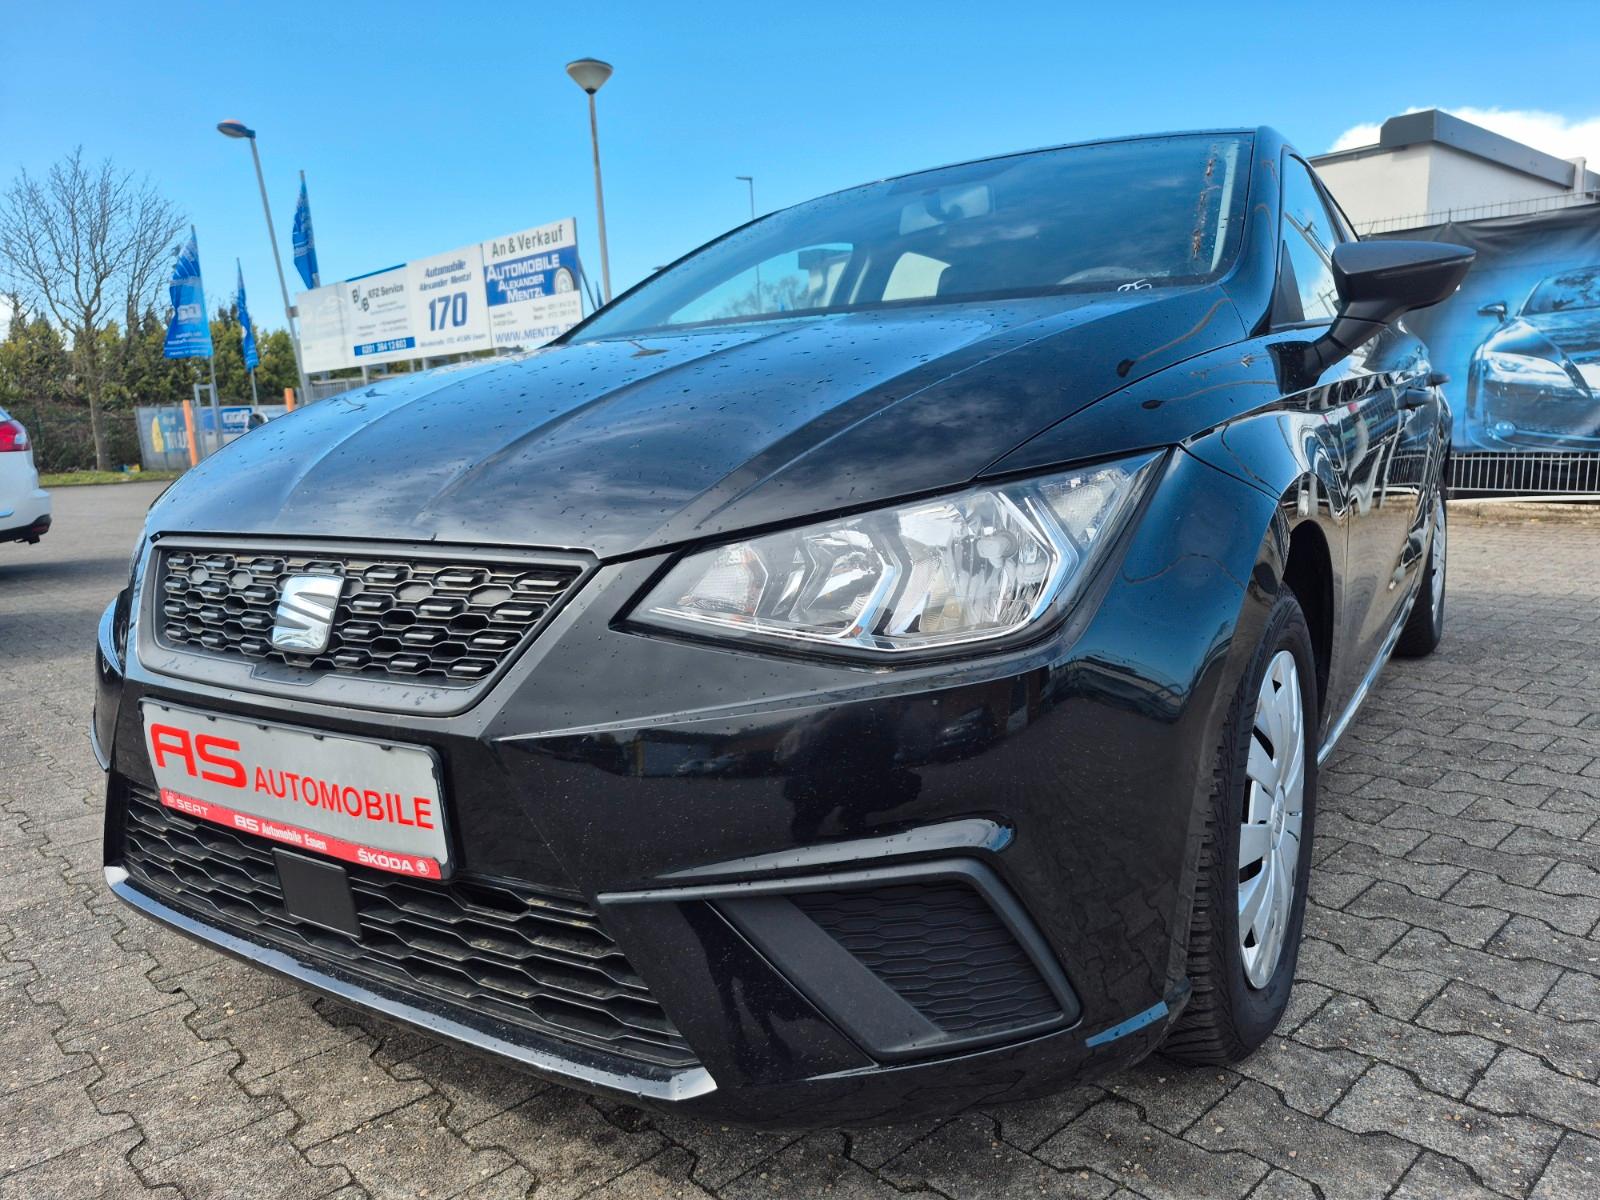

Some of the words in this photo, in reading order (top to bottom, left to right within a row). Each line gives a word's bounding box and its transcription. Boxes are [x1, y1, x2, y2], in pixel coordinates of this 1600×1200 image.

[492, 242, 506, 258] An
[508, 238, 516, 254] &
[517, 225, 563, 251] Verkauf
[424, 260, 466, 278] Automobile
[486, 254, 560, 283] AUTOMOBILE
[380, 283, 404, 296] Service
[419, 279, 448, 291] Alexander
[498, 274, 545, 293] ALEXANDER
[507, 287, 545, 303] MENTZL
[429, 291, 468, 331] 170
[150, 723, 247, 789] AS
[255, 766, 434, 830] AUTOMOBILE
[176, 799, 208, 816] SEAT
[261, 822, 302, 844] Automobile
[304, 832, 327, 850] Essen
[357, 847, 414, 873] ŠKODA
